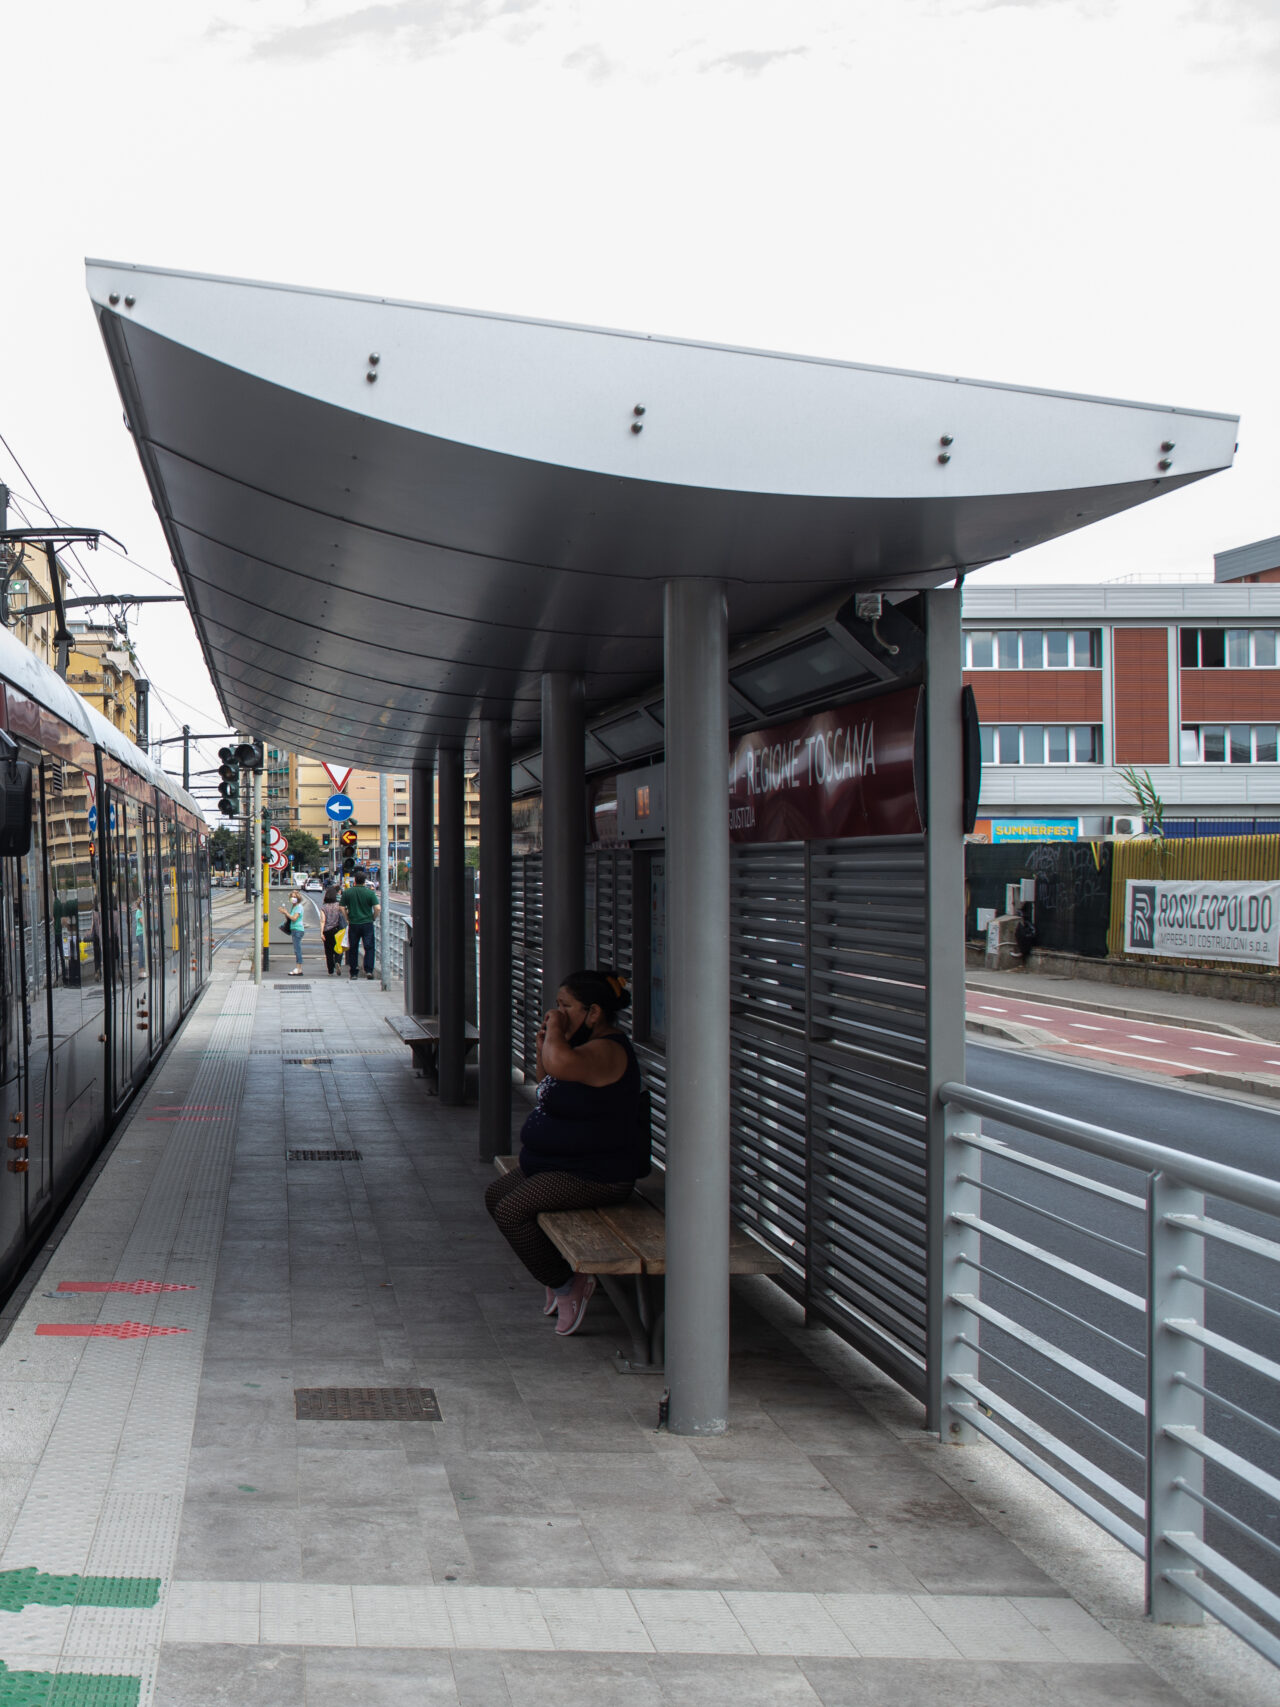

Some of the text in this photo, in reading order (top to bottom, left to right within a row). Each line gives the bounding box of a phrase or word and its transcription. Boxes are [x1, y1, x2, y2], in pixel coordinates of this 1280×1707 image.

[746, 738, 801, 796] REGIONE
[804, 719, 877, 786] TOSCANA
[995, 825, 1076, 836] SUMMERFEST
[1158, 893, 1273, 934] ROSILEOPOLDO
[1159, 933, 1271, 953] IMPRESA DI COSTRUZIONI s.p.a.
